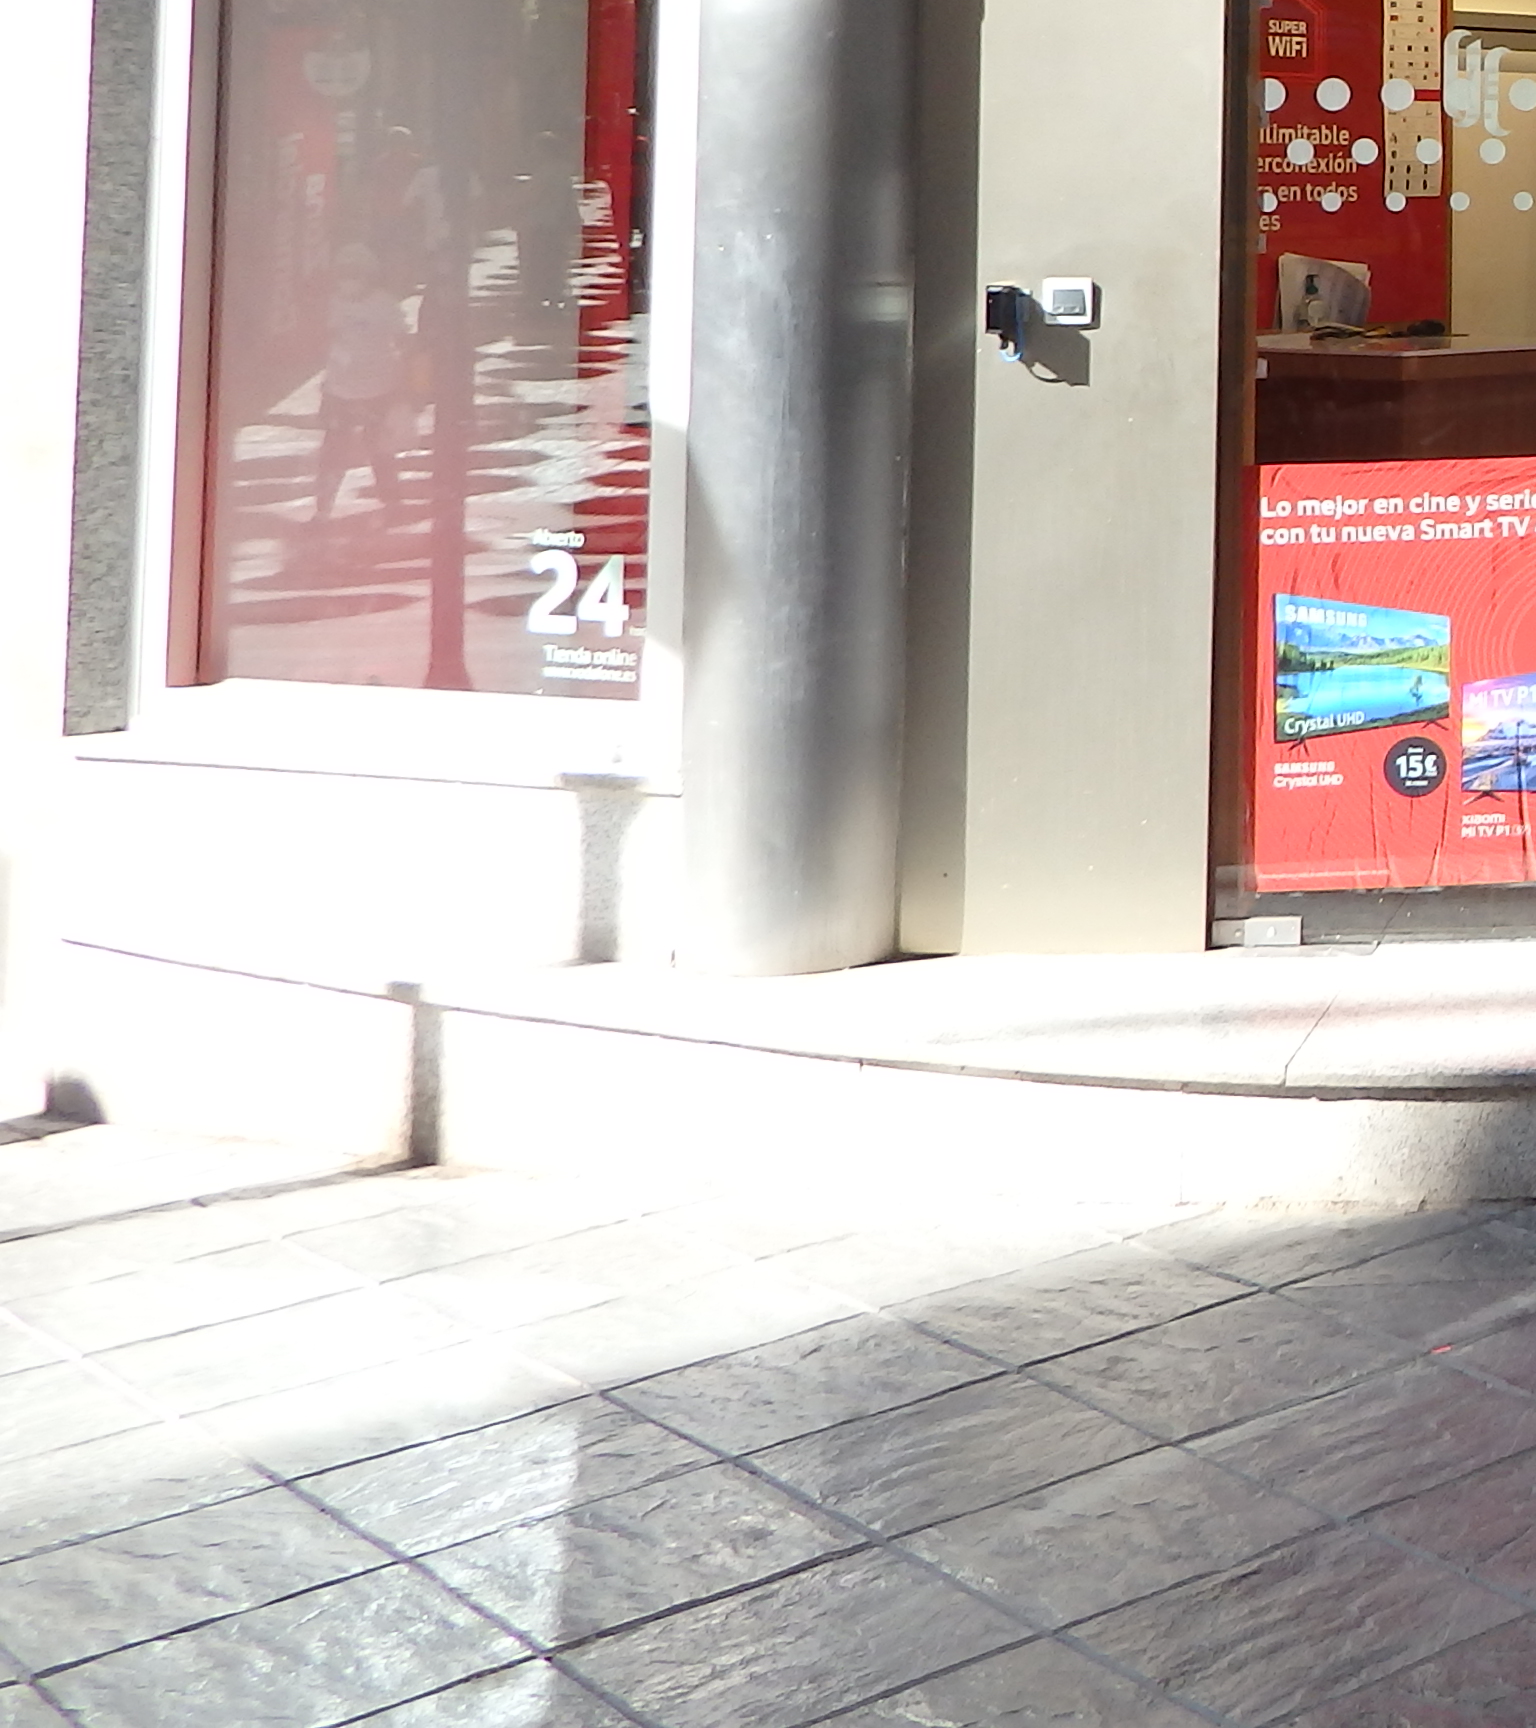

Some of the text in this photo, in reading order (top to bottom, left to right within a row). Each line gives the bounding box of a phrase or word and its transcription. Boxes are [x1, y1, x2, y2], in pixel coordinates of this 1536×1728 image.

[1268, 20, 1307, 35] SUPER
[1268, 36, 1307, 58] WiFi
[1277, 185, 1301, 202] en
[1260, 496, 1292, 518] Lo
[1297, 495, 1369, 520] mejor
[1374, 497, 1402, 515] en
[1409, 491, 1460, 514] cine
[1465, 494, 1482, 516] y
[1260, 525, 1305, 545] con
[1311, 523, 1337, 544] tu
[1342, 524, 1415, 543] nueva
[1420, 517, 1493, 540] Smart
[1497, 515, 1528, 536] TV
[527, 549, 630, 638] 24
[1284, 604, 1368, 627] SAMSUNG
[543, 644, 637, 666] Tienda online
[1490, 687, 1515, 707] TV
[1284, 710, 1365, 735] Crystal UHD
[1273, 775, 1318, 790] Crystal
